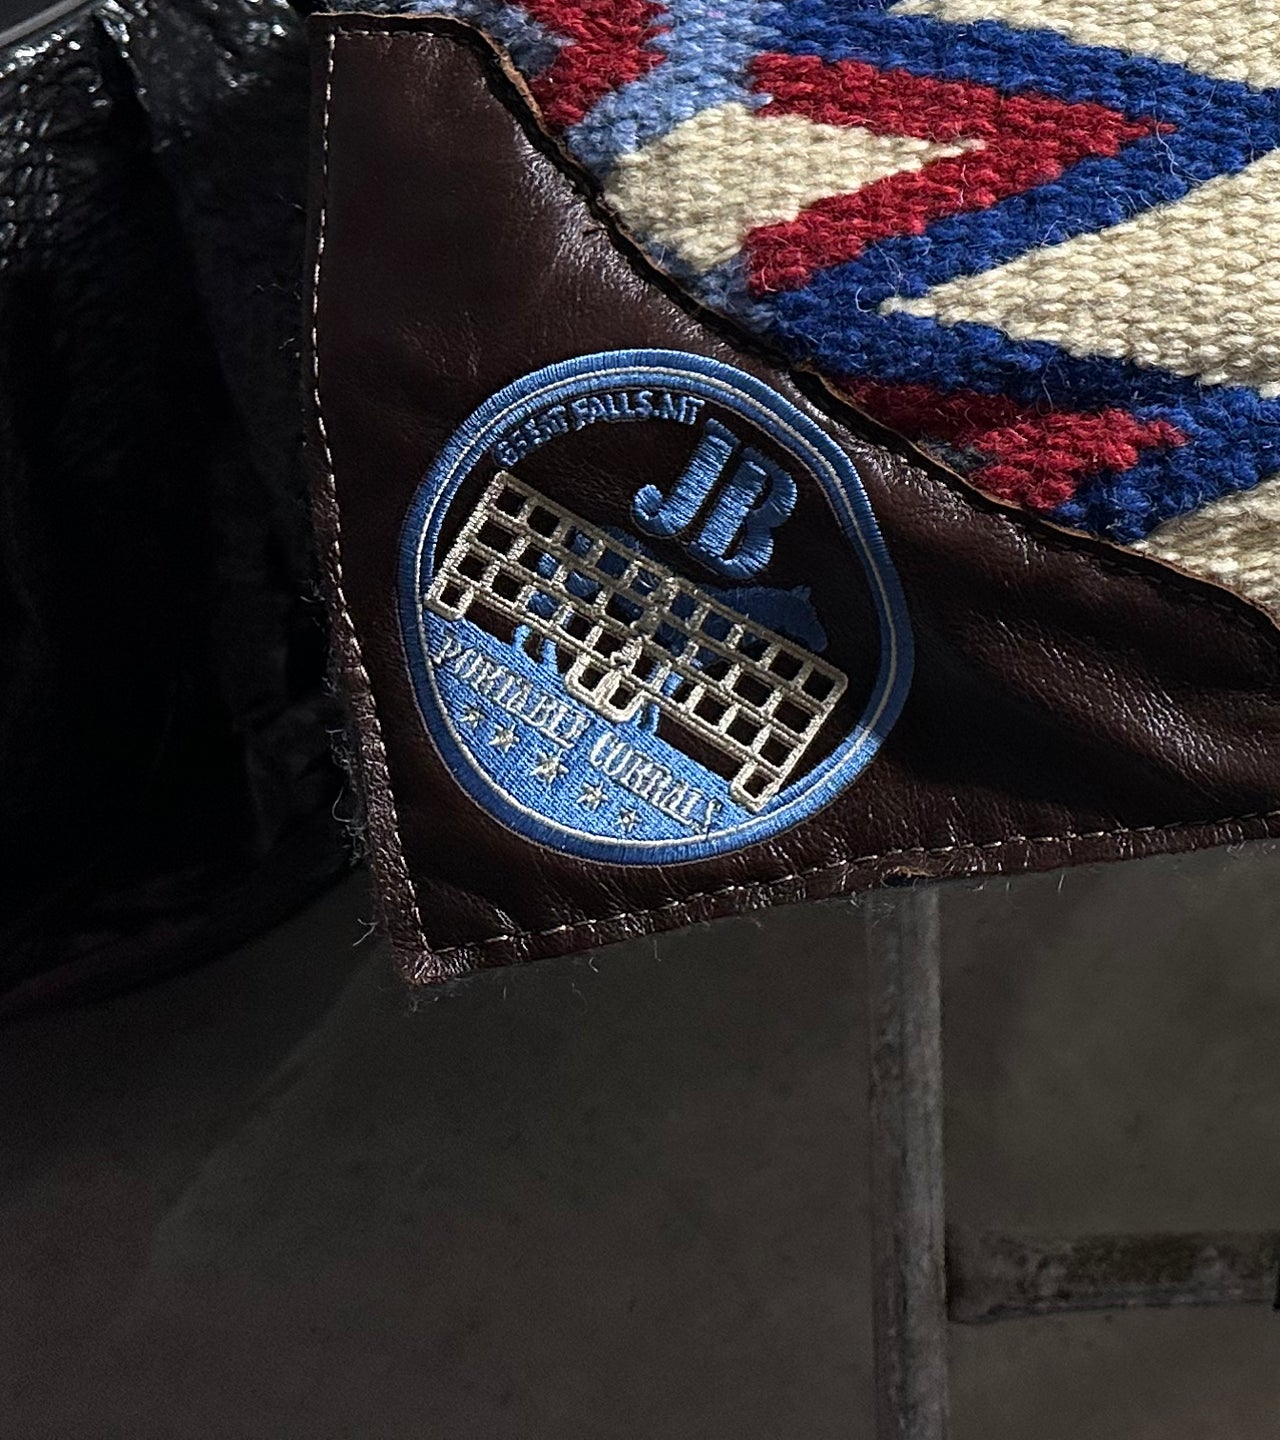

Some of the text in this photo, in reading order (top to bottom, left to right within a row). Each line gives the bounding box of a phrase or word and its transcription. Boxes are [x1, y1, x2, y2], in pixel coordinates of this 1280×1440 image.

[632, 417, 798, 580] JB
[431, 634, 723, 835] PORTABLE CORRALS
